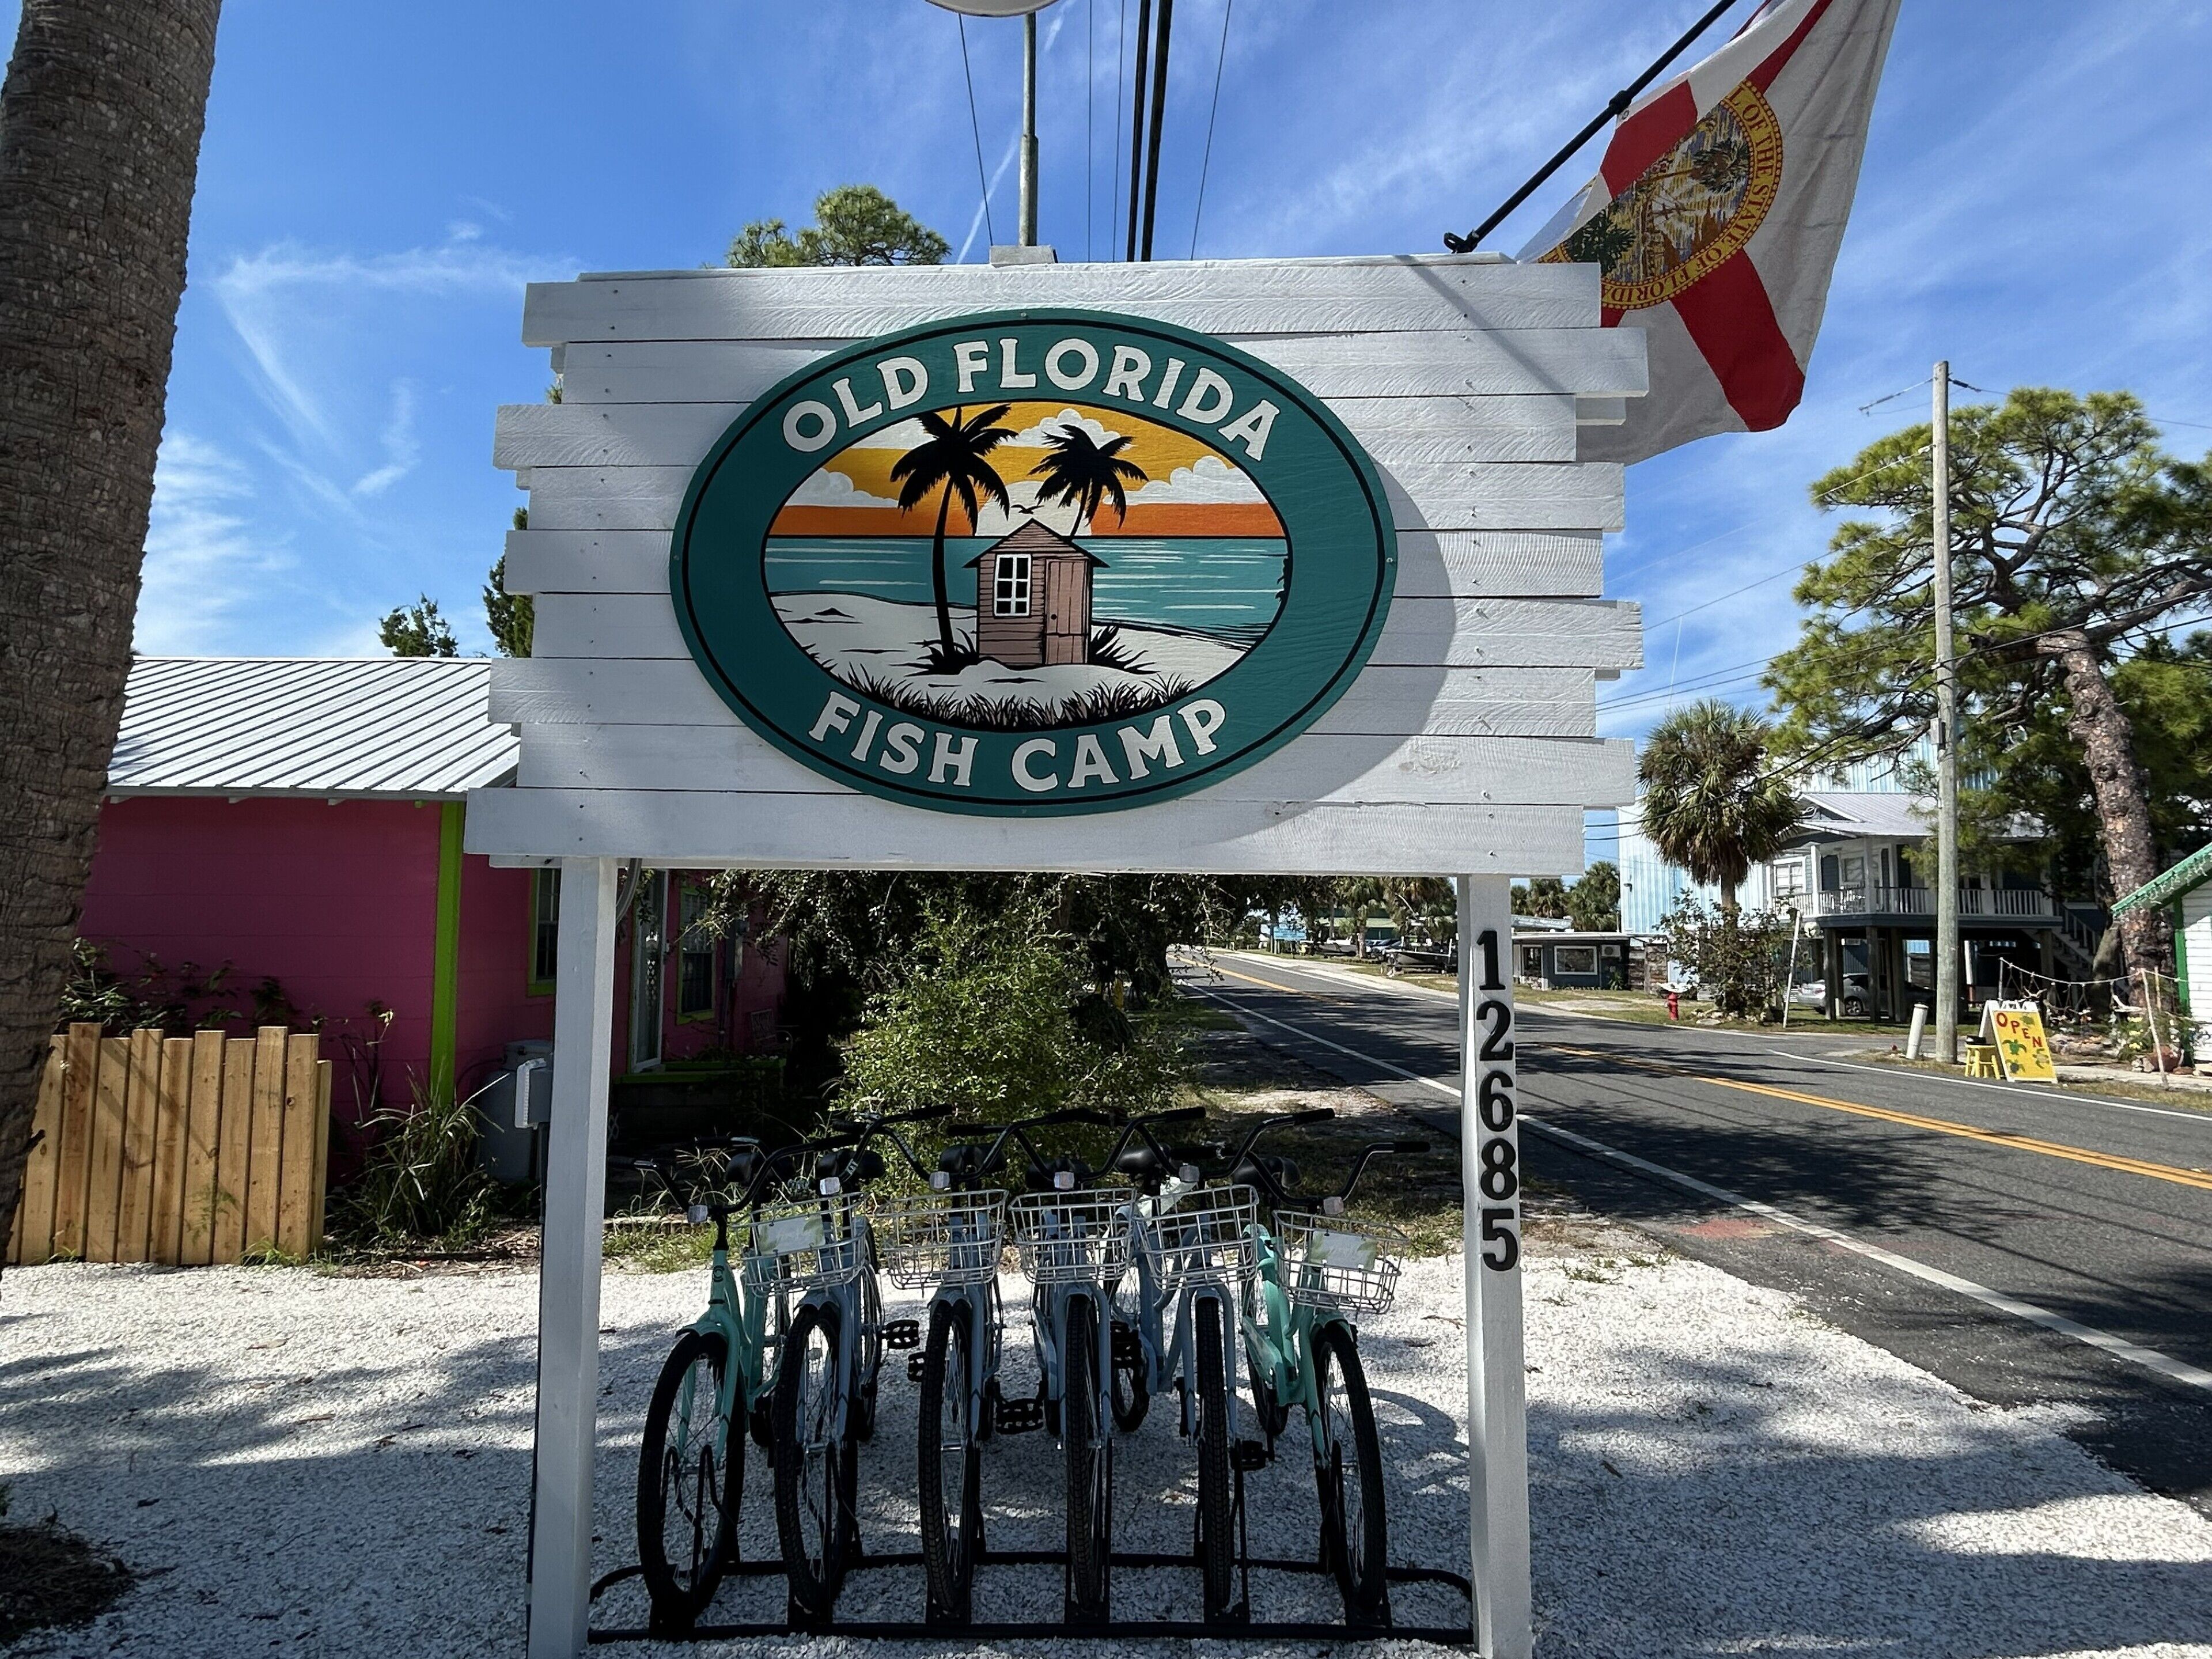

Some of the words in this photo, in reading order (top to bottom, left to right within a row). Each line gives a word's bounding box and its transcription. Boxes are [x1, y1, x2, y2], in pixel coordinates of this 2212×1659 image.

[1741, 104, 1768, 131] OF
[1755, 132, 1774, 179] THE
[1722, 184, 1770, 248] STATE
[1696, 247, 1722, 272] OF
[782, 355, 929, 453] OLD
[952, 337, 1281, 463] FLORIDA
[808, 691, 980, 788] FISH
[1010, 698, 1226, 792] CAMP
[1996, 1012, 2043, 1048] OPEN
[1475, 930, 1518, 1271] 12685
